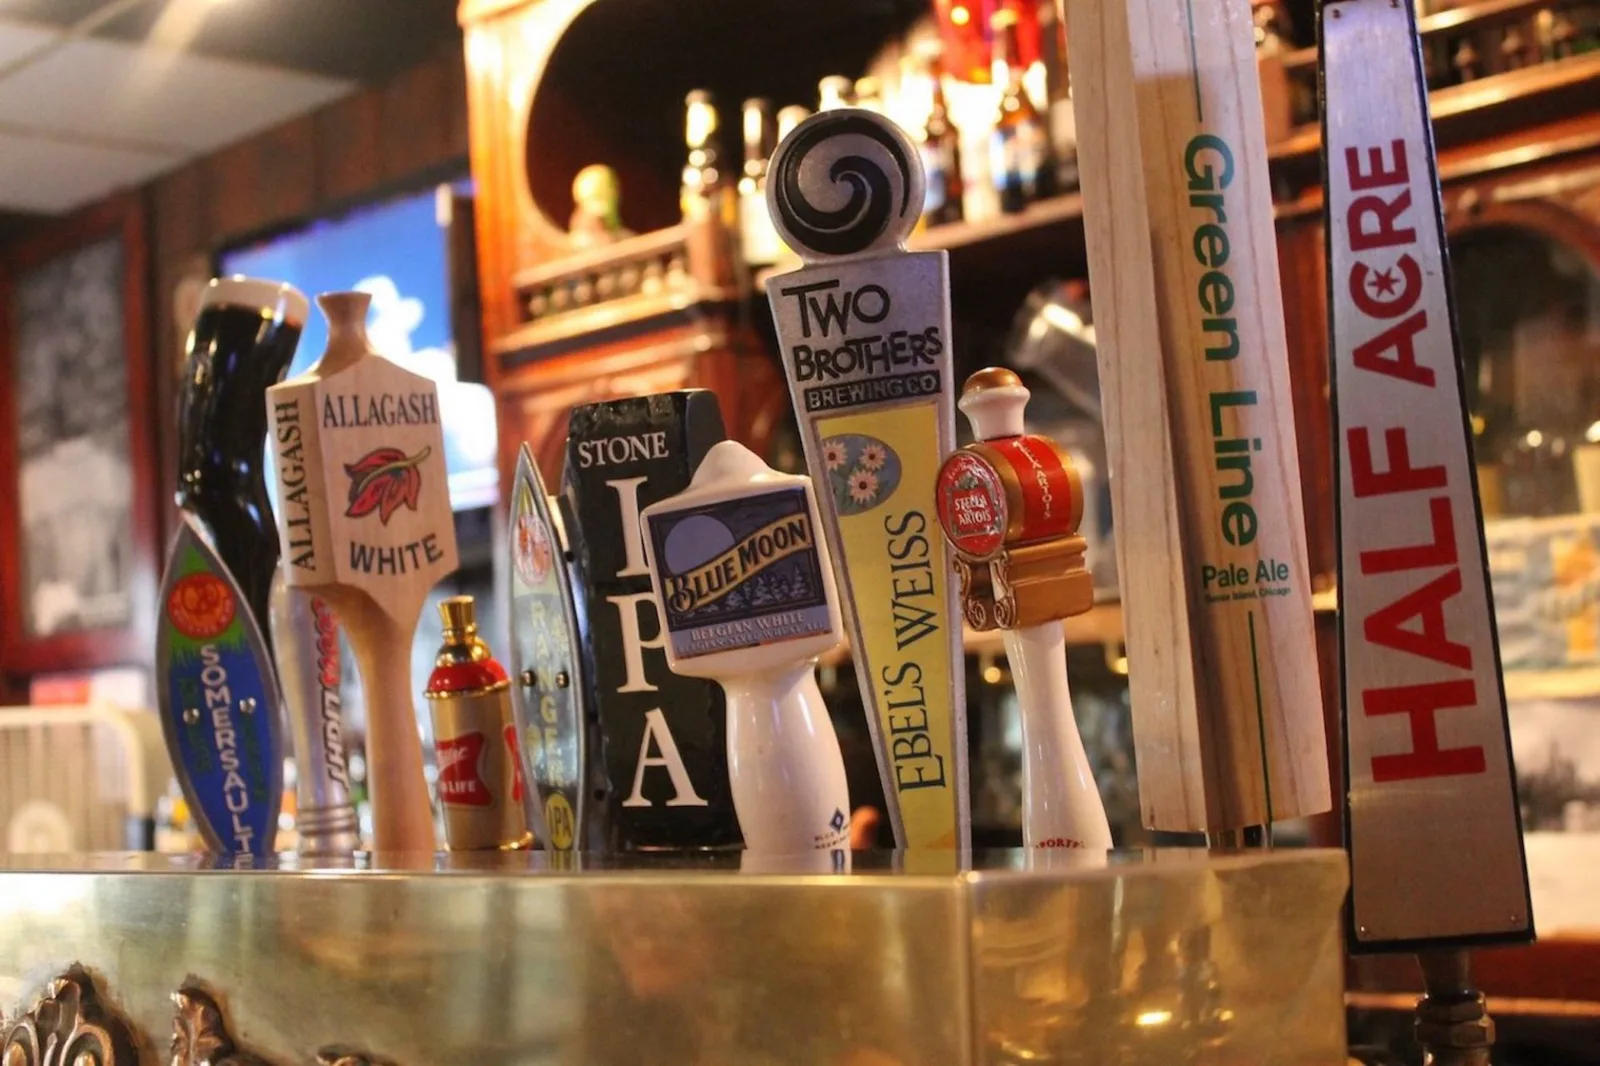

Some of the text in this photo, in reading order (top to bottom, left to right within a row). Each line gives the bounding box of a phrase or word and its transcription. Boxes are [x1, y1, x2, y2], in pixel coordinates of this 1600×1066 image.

[781, 279, 890, 337] TWO
[793, 327, 943, 381] BROTHERS
[1185, 134, 1262, 547] Green Line
[323, 393, 439, 429] ALLAGASH
[807, 379, 903, 409] BREWING
[578, 432, 669, 468] STONE
[1345, 139, 1486, 783] HALF ACRE
[275, 399, 317, 572] ALLAGASH
[955, 494, 988, 511] STELLA
[958, 510, 992, 526] ARTOIS
[350, 533, 444, 575] WHITE
[666, 519, 806, 614] BLUE MOON
[1202, 558, 1290, 589] Pale Ale
[605, 476, 709, 807] IPA
[691, 612, 804, 642] BELGIAN WHITE
[882, 510, 946, 793] EBEL'S WEISS
[549, 804, 572, 838] IPA
